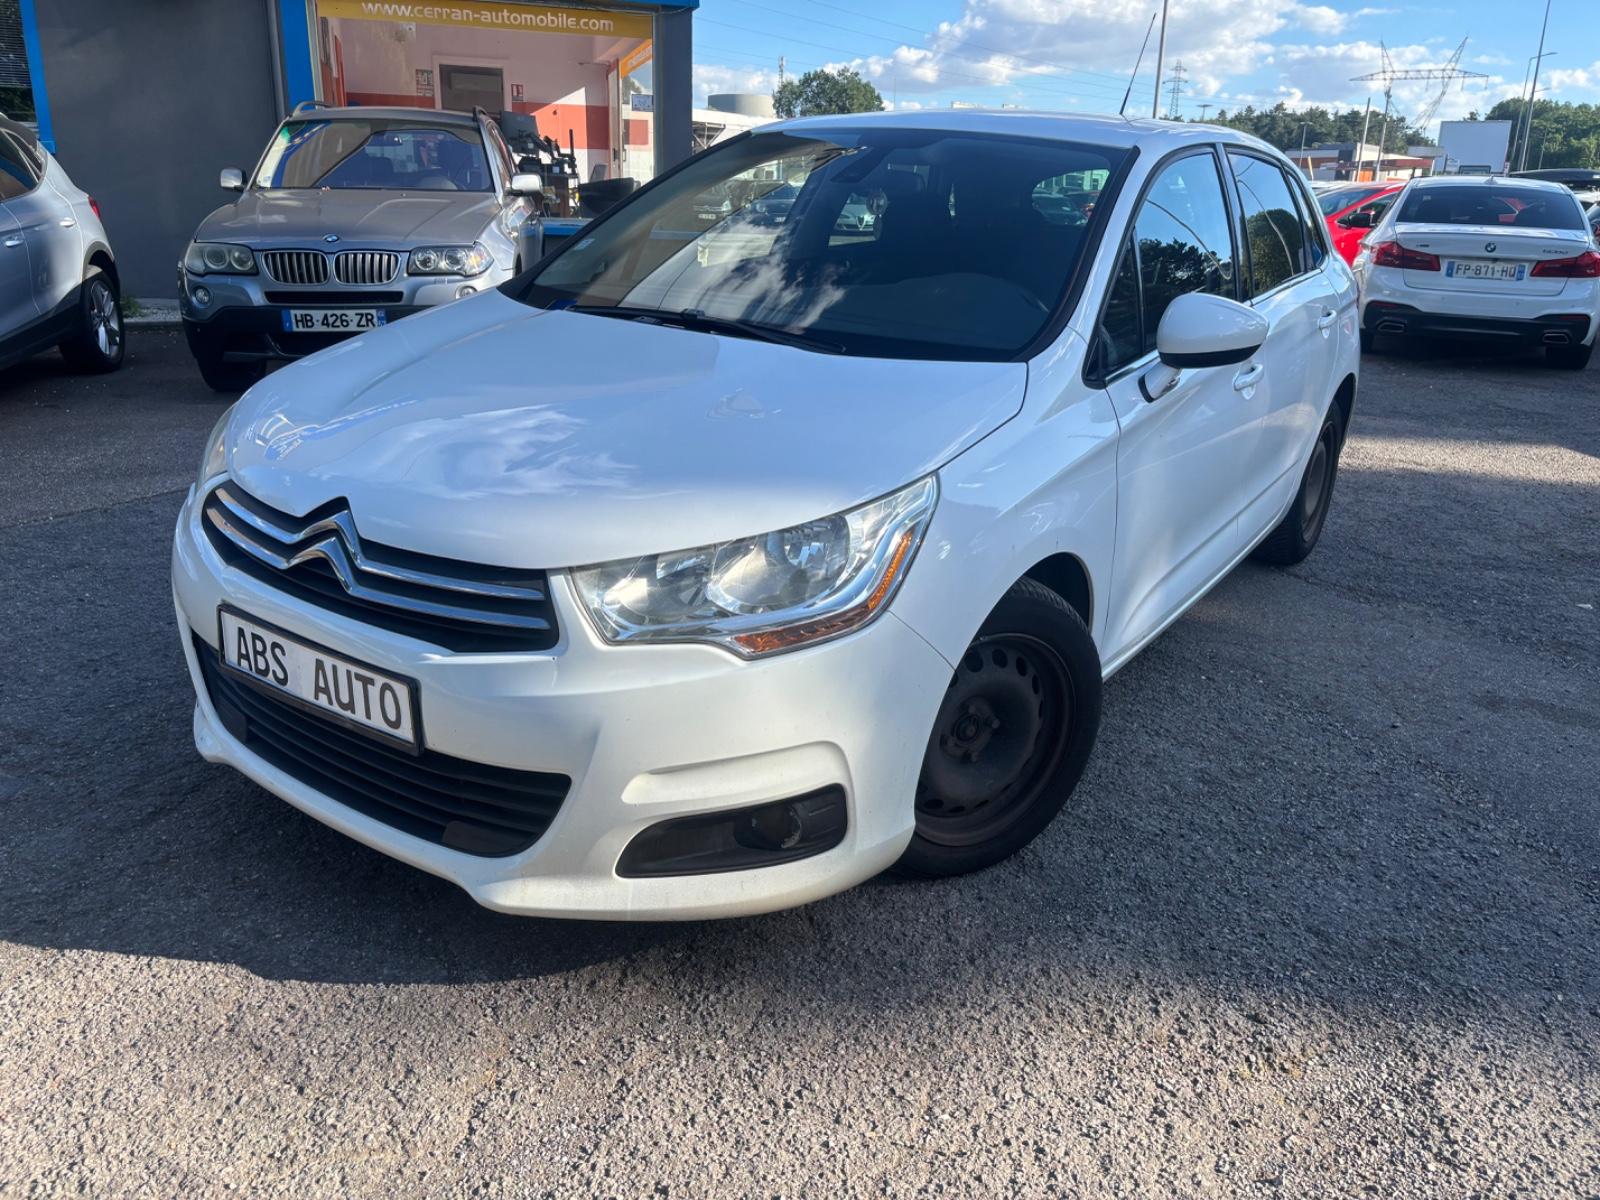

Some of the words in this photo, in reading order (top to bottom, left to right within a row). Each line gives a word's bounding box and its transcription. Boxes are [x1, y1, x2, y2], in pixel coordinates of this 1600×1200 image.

[362, 2, 614, 32] www.cerran-automobile.com
[237, 626, 289, 687] ABS
[314, 658, 402, 730] AUTO
